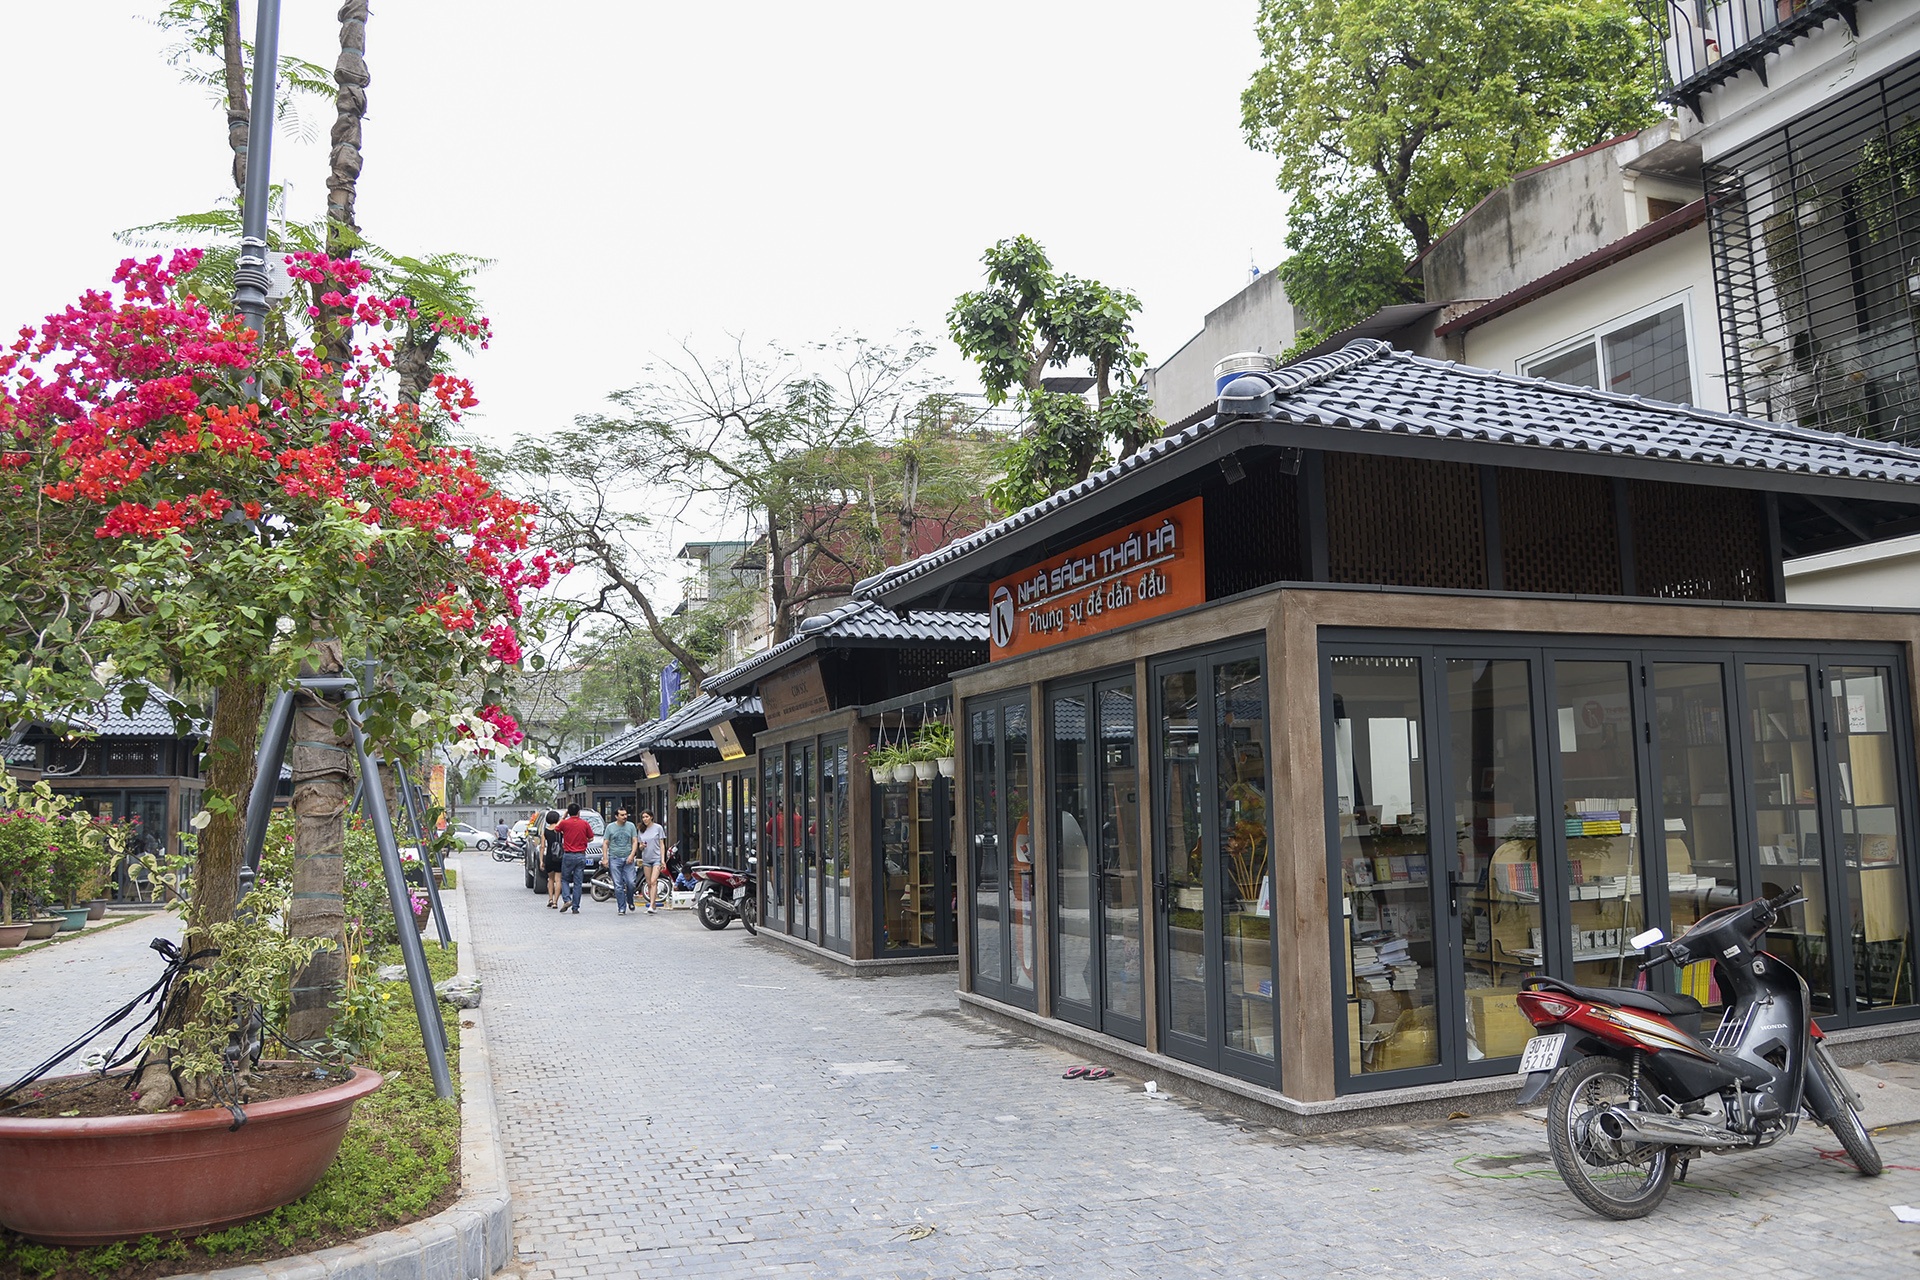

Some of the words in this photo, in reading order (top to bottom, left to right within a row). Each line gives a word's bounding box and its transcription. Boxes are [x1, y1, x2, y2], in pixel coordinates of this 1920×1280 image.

[1017, 570, 1048, 604] NHÀ
[1050, 554, 1096, 592] SÁCH
[1099, 533, 1141, 573] THÁI
[1146, 519, 1175, 557] HÀ
[1028, 608, 1063, 635] Phụng
[1069, 599, 1083, 625] sự
[1086, 583, 1103, 616] để
[1107, 580, 1132, 609] dẫn
[1760, 1023, 1788, 1031] HONDA
[1529, 1037, 1558, 1054] 30-H1
[1524, 1053, 1553, 1070] 5216
